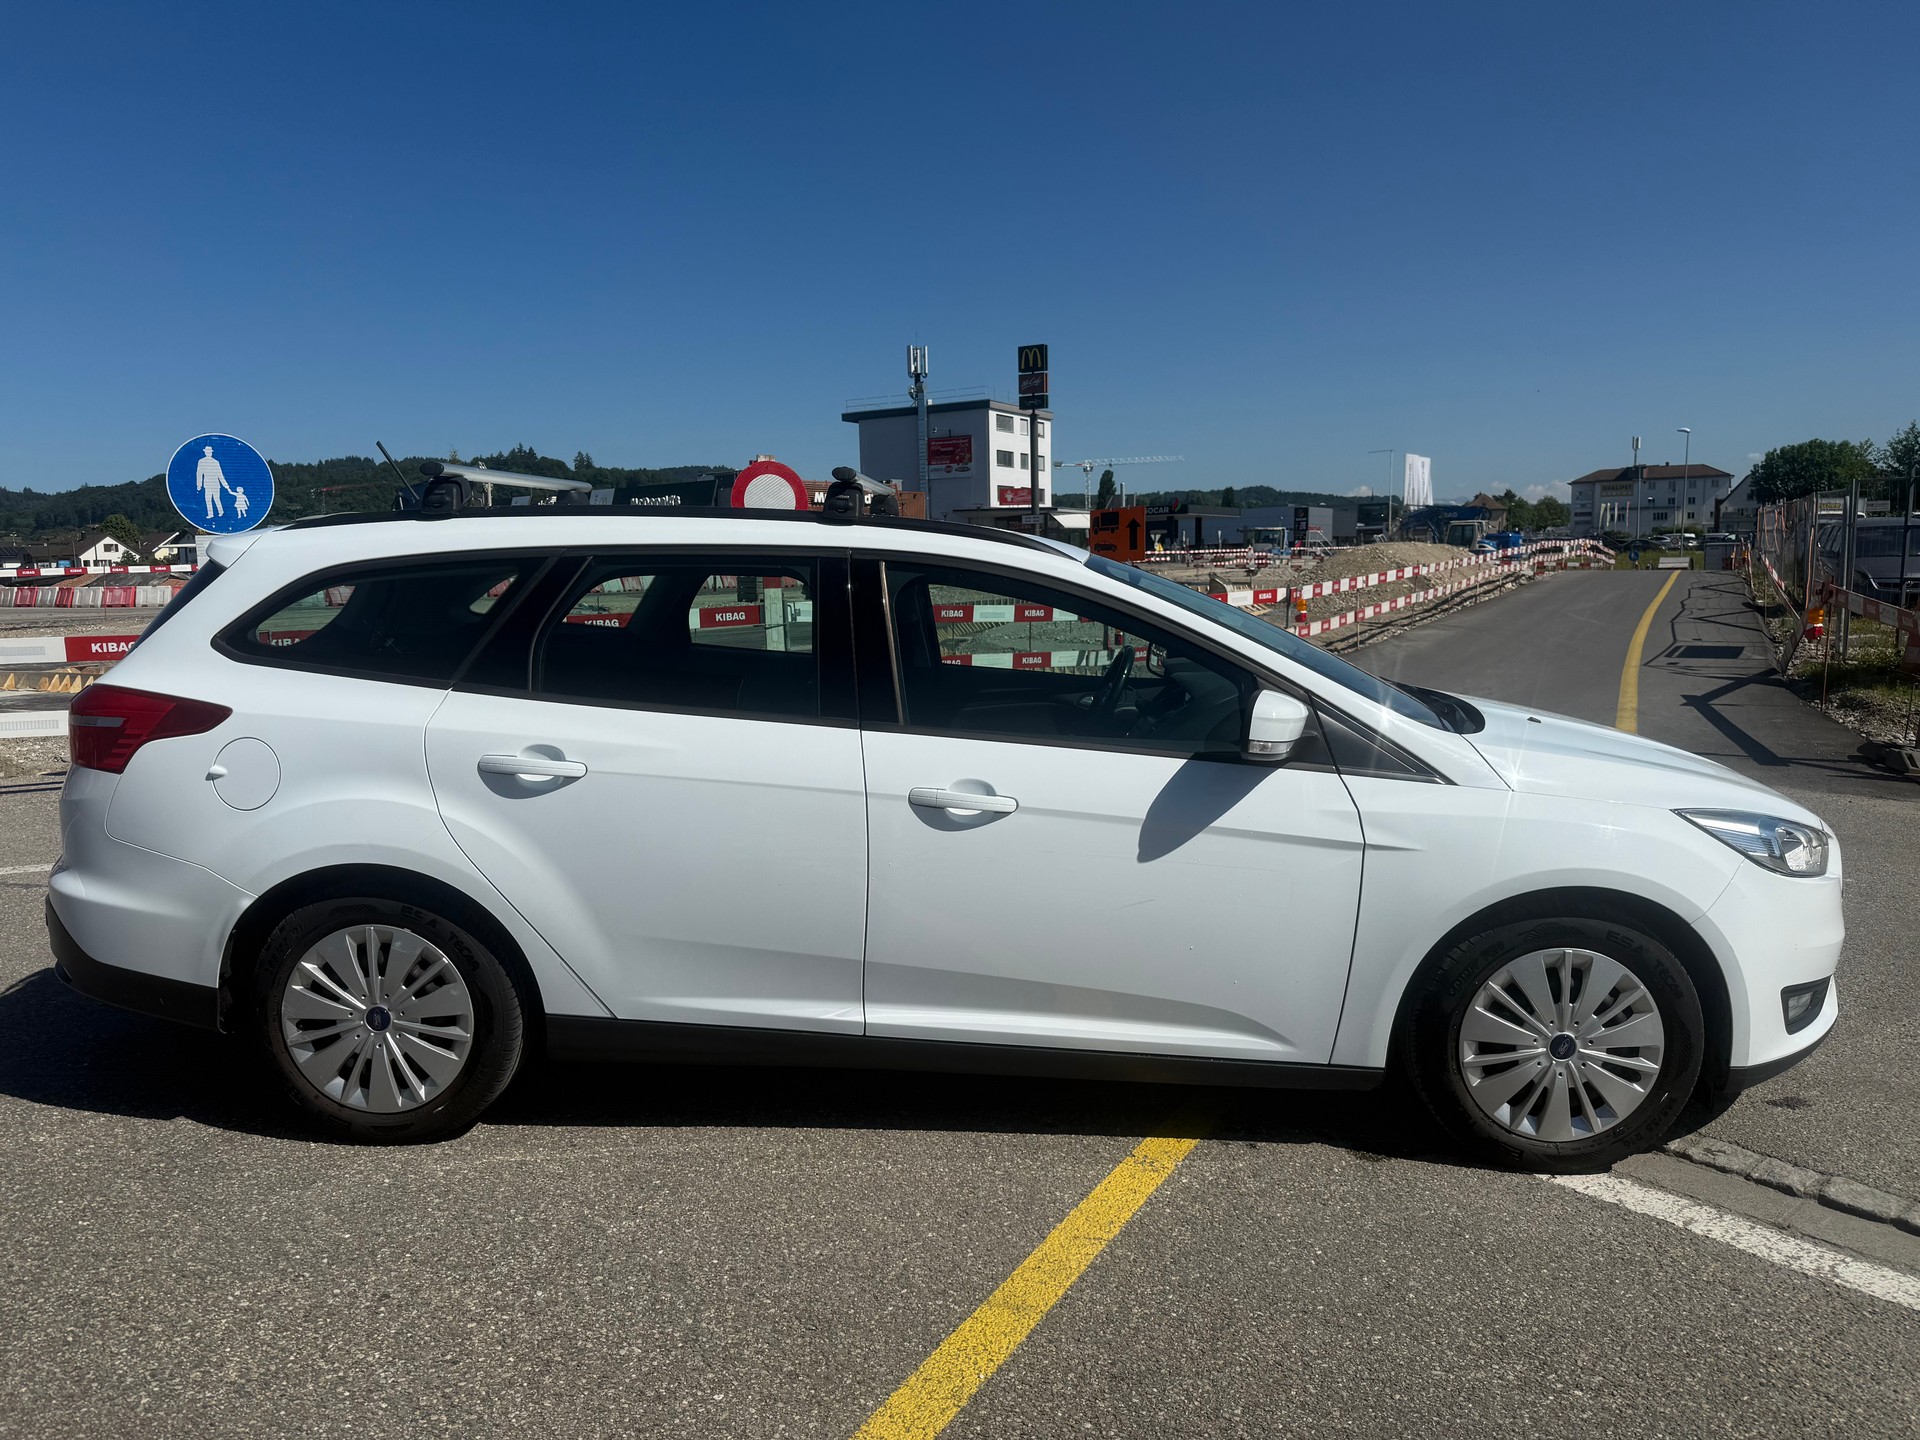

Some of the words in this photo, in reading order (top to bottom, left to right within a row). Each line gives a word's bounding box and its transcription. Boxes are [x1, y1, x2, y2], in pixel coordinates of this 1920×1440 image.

[715, 612, 746, 621] KIBAG
[1024, 609, 1045, 617] KIBAG
[1022, 656, 1042, 664] KIBAG
